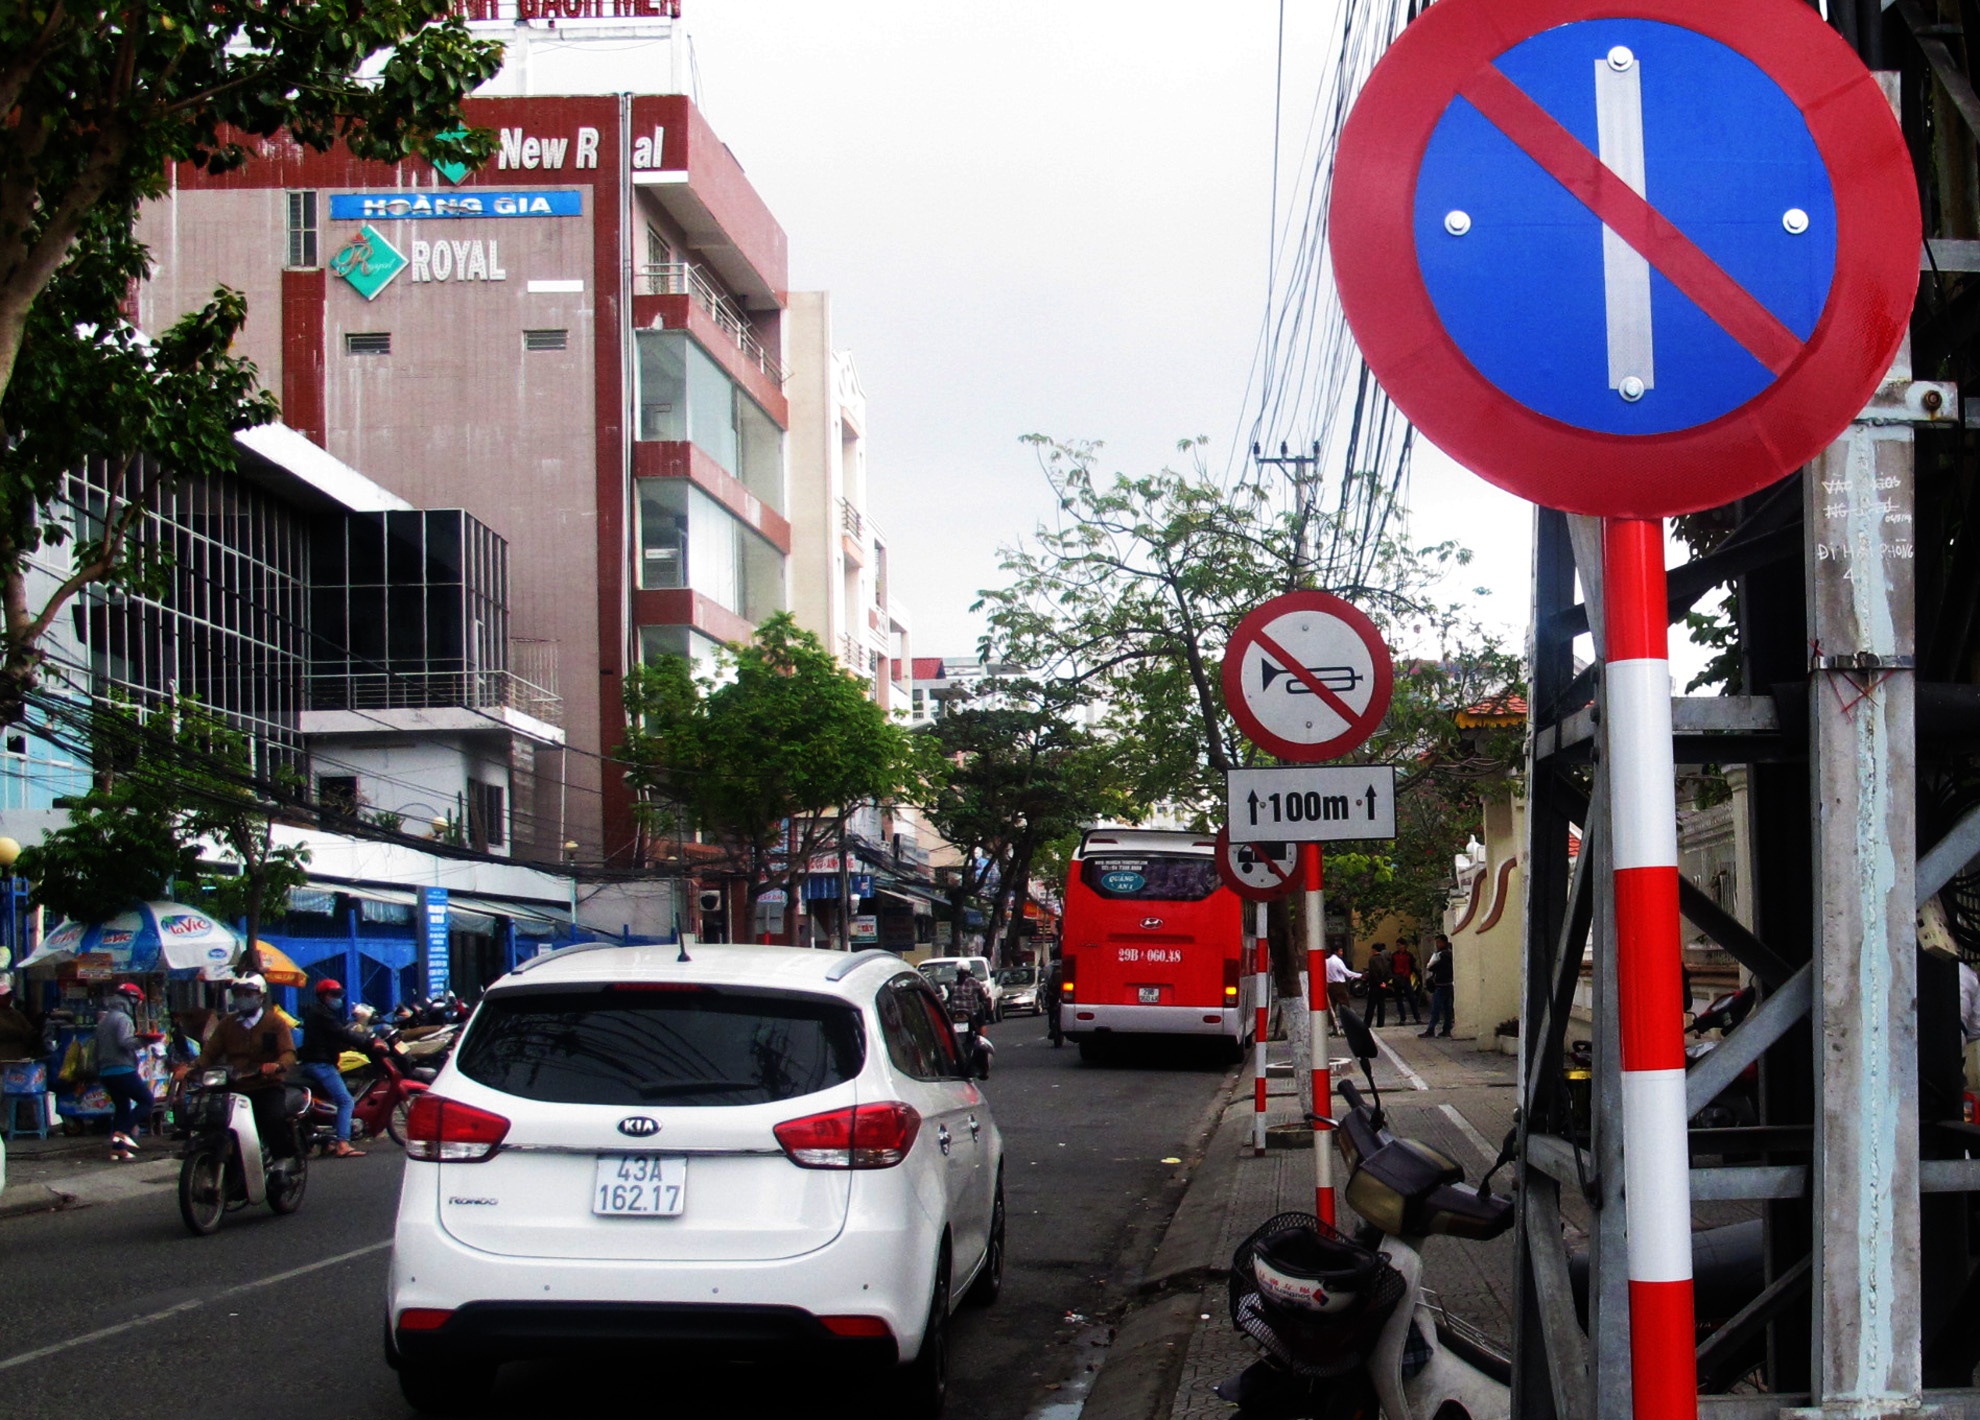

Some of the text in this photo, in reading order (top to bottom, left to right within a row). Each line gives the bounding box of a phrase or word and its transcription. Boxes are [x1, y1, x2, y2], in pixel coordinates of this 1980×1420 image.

[498, 127, 568, 170] New
[364, 195, 552, 216] HOÀNG GIA
[411, 240, 507, 282] ROYAL
[1269, 791, 1349, 822] 100m
[624, 1119, 655, 1133] KIA
[617, 1157, 662, 1182] 43A
[600, 1184, 681, 1212] 162.17
